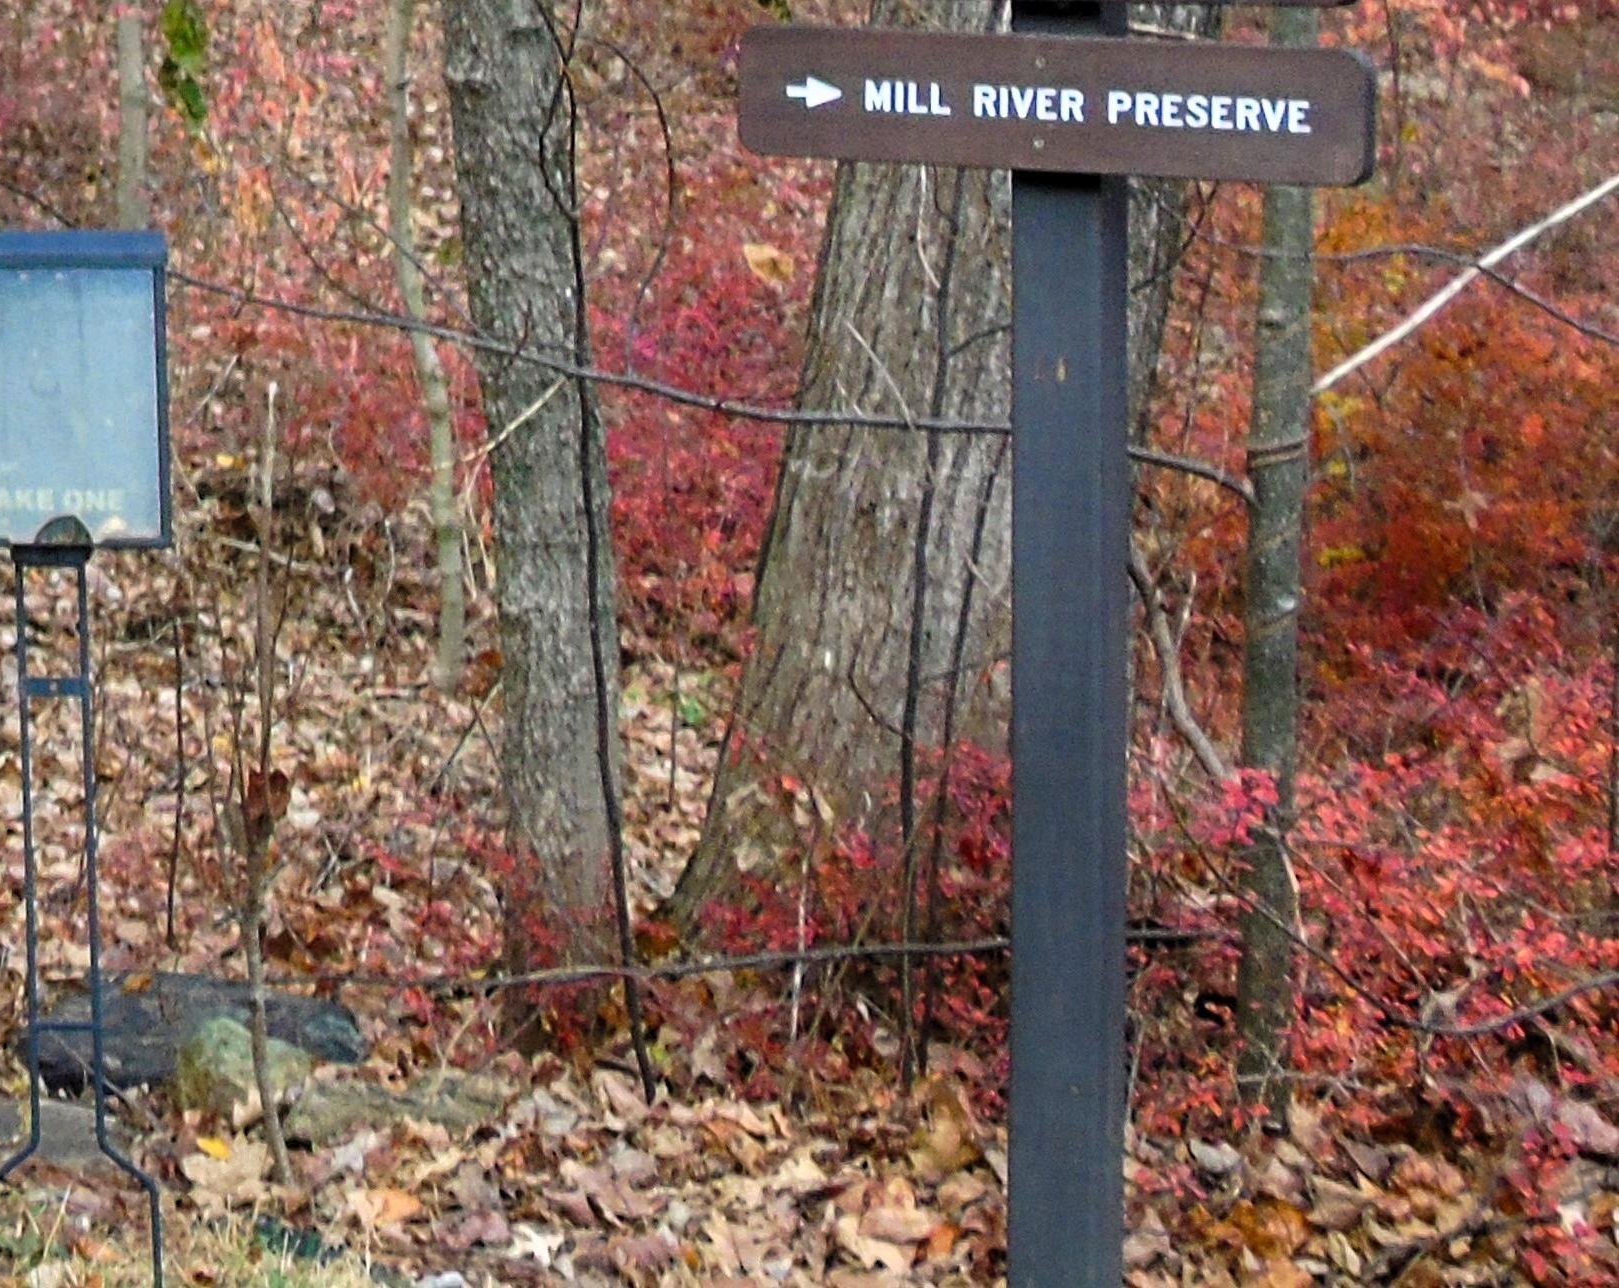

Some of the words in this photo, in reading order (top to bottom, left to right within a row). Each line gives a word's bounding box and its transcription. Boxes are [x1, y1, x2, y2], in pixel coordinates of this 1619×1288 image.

[864, 80, 951, 116] MILL
[972, 84, 1085, 123] RIVER
[1107, 91, 1312, 135] PRESERVE
[63, 488, 123, 511] ONE
